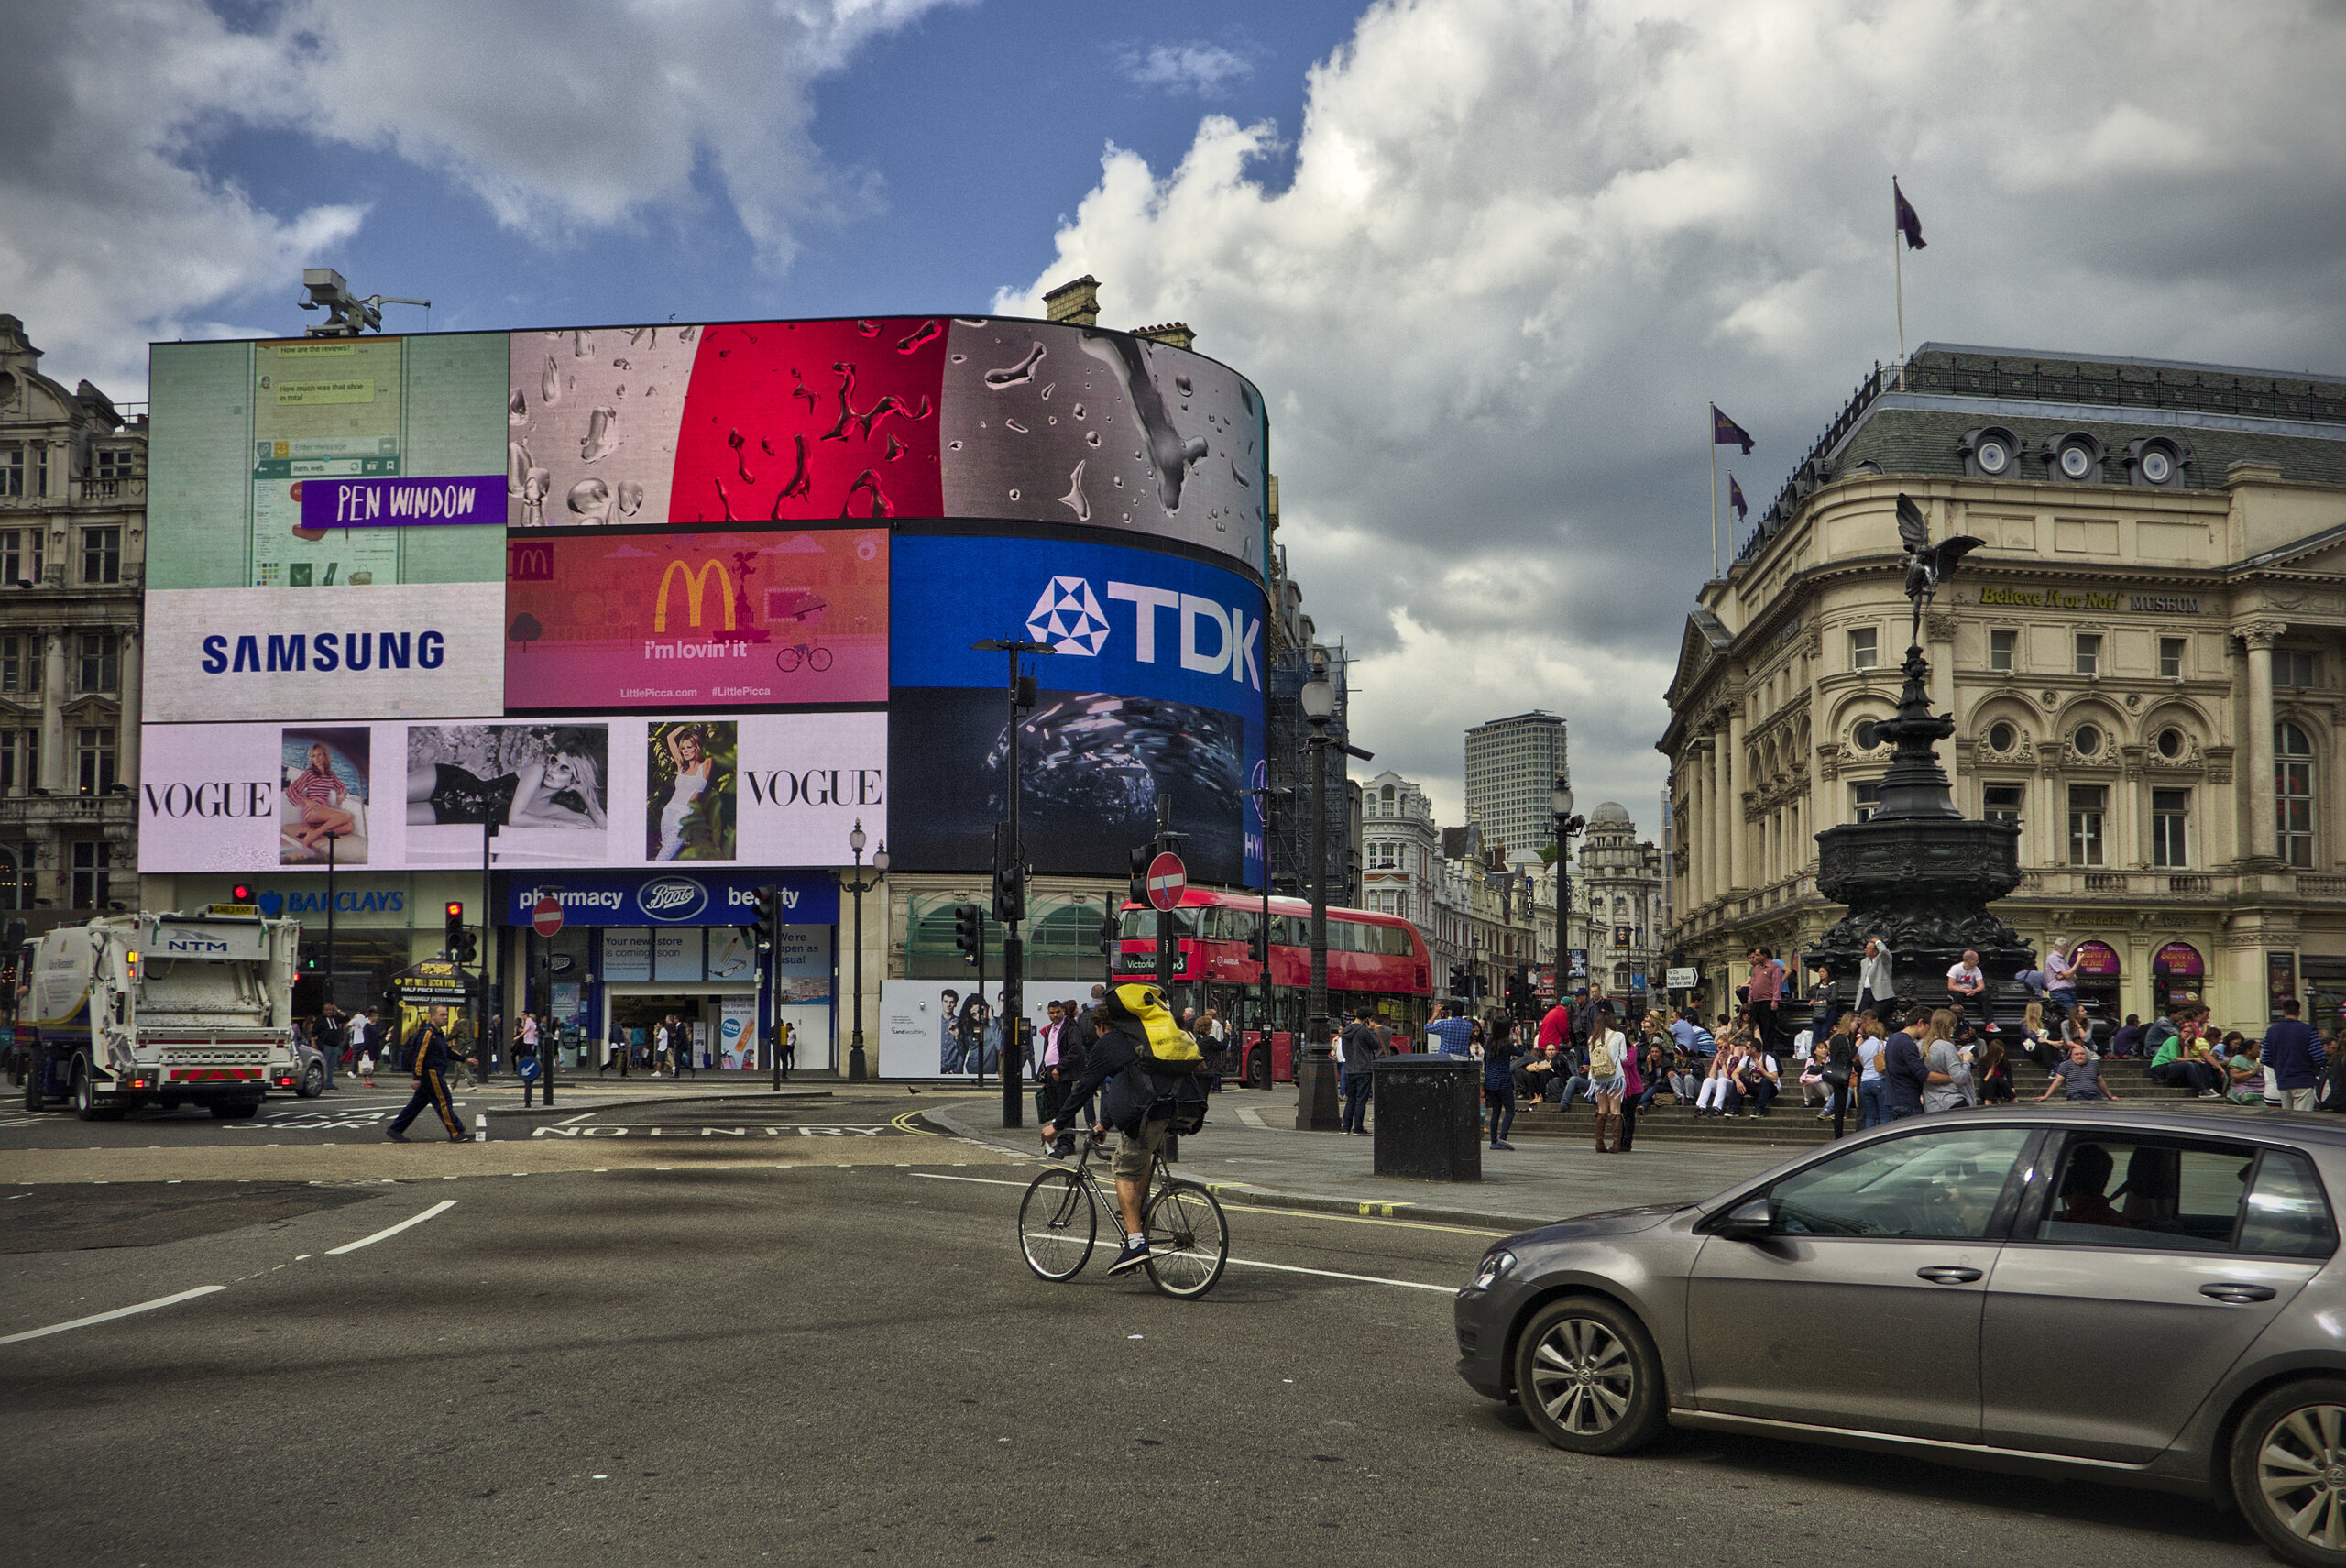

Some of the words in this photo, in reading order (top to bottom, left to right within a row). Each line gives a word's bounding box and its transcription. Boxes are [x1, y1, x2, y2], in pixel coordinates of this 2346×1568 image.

[296, 384, 315, 392] much
[295, 442, 312, 451] Enter
[337, 485, 381, 521] PEN
[389, 485, 476, 519] WINDOW
[1981, 587, 2042, 606] Believe
[2045, 589, 2061, 607] It
[2065, 596, 2082, 608] or
[2086, 591, 2122, 610] Not!
[2132, 595, 2199, 611] MUSEUM
[1107, 580, 1261, 693] TDK
[202, 630, 444, 674] SAMSUNG
[645, 641, 674, 659] i'm
[677, 640, 729, 658] lovin'
[733, 640, 747, 657] it
[620, 688, 697, 698] LittlePicca.com
[712, 686, 771, 697] #LittlePicca
[743, 769, 882, 806] VOGUE
[142, 782, 272, 818] VOGUE
[646, 884, 695, 909] Boots
[606, 937, 628, 946] Your
[657, 938, 683, 946] store
[781, 933, 806, 941] We're
[169, 941, 227, 951] NTM
[781, 945, 804, 953] open
[606, 948, 613, 957] is
[616, 948, 651, 959] coming
[1127, 960, 1155, 969] Victoria
[724, 1022, 740, 1031] new
[531, 1126, 629, 1137] NO
[651, 1126, 885, 1136] ENTRY
